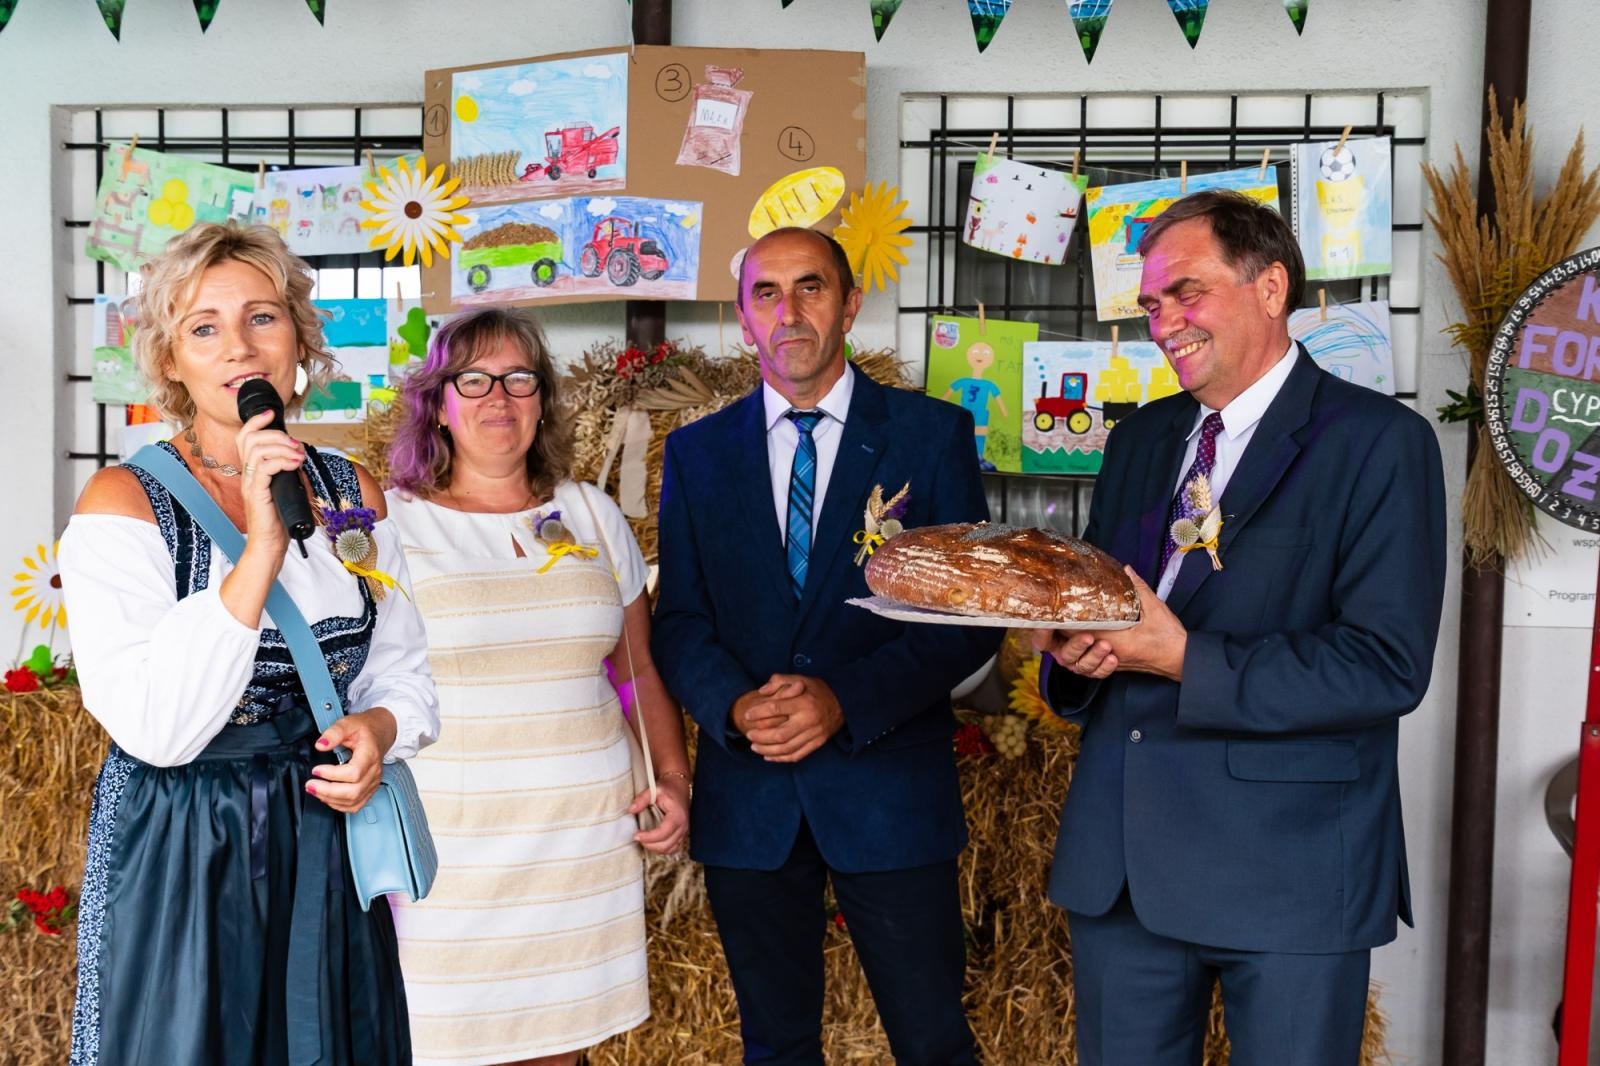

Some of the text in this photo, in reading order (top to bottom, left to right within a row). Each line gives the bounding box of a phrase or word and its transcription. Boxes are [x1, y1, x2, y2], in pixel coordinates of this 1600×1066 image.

[1551, 266, 1567, 281] 43
[1564, 259, 1579, 274] 42
[1528, 285, 1544, 299] 45
[1518, 296, 1533, 310] 46
[1495, 336, 1509, 350] 49
[1490, 348, 1505, 364] 50
[1489, 420, 1504, 436] 55
[1493, 435, 1509, 451] 56
[1499, 450, 1516, 464] 57
[1506, 461, 1524, 478] 58
[1515, 473, 1533, 489] 59
[1526, 482, 1542, 498] 60
[1538, 493, 1549, 503] 1
[1547, 499, 1560, 512] 2
[1560, 507, 1572, 519] 3
[1576, 513, 1587, 527] 4
